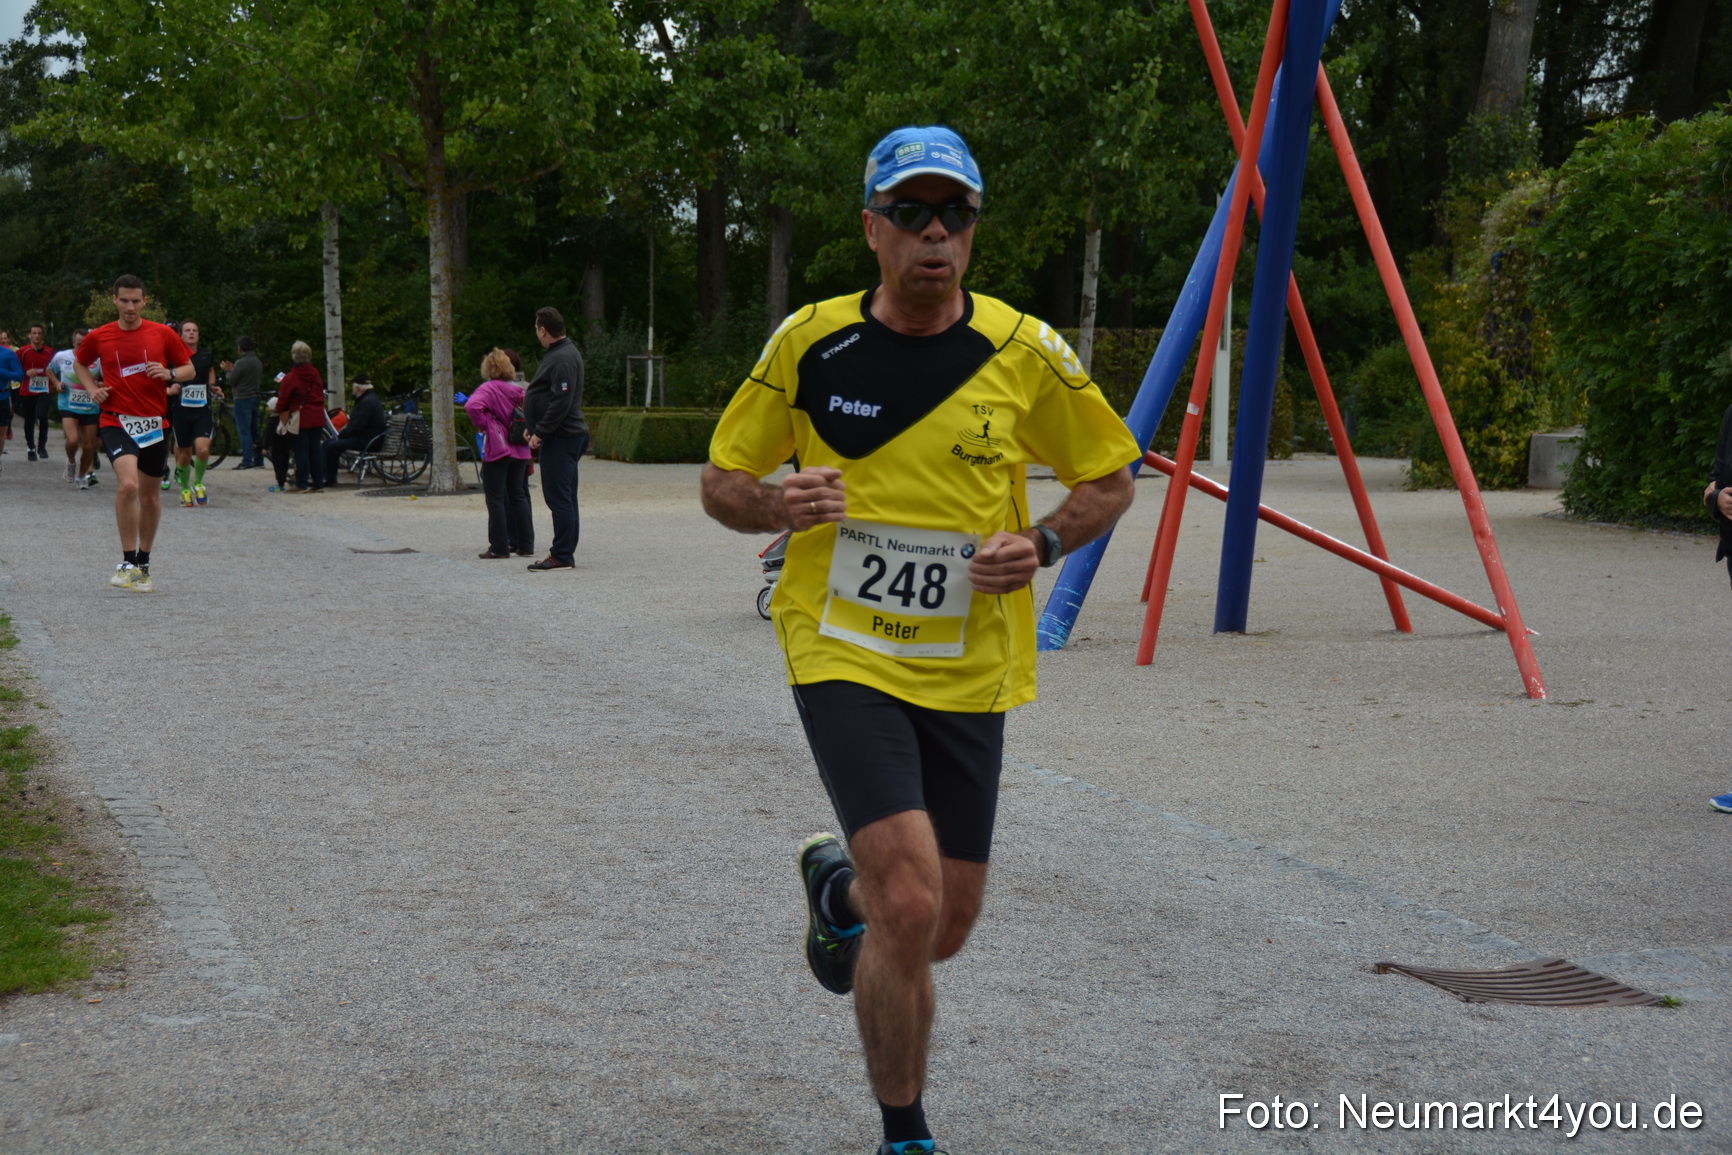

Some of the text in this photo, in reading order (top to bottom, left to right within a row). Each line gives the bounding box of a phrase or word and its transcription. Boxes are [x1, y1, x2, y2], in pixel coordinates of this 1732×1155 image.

[821, 332, 861, 360] STANNO
[184, 390, 205, 399] 2476
[828, 395, 882, 418] Peter
[972, 404, 994, 417] TSV
[125, 419, 159, 436] 2335
[951, 443, 1004, 466] Burgthann
[840, 527, 955, 557] PARTL Neumarkt
[857, 554, 947, 609] 248
[872, 616, 920, 640] Peter
